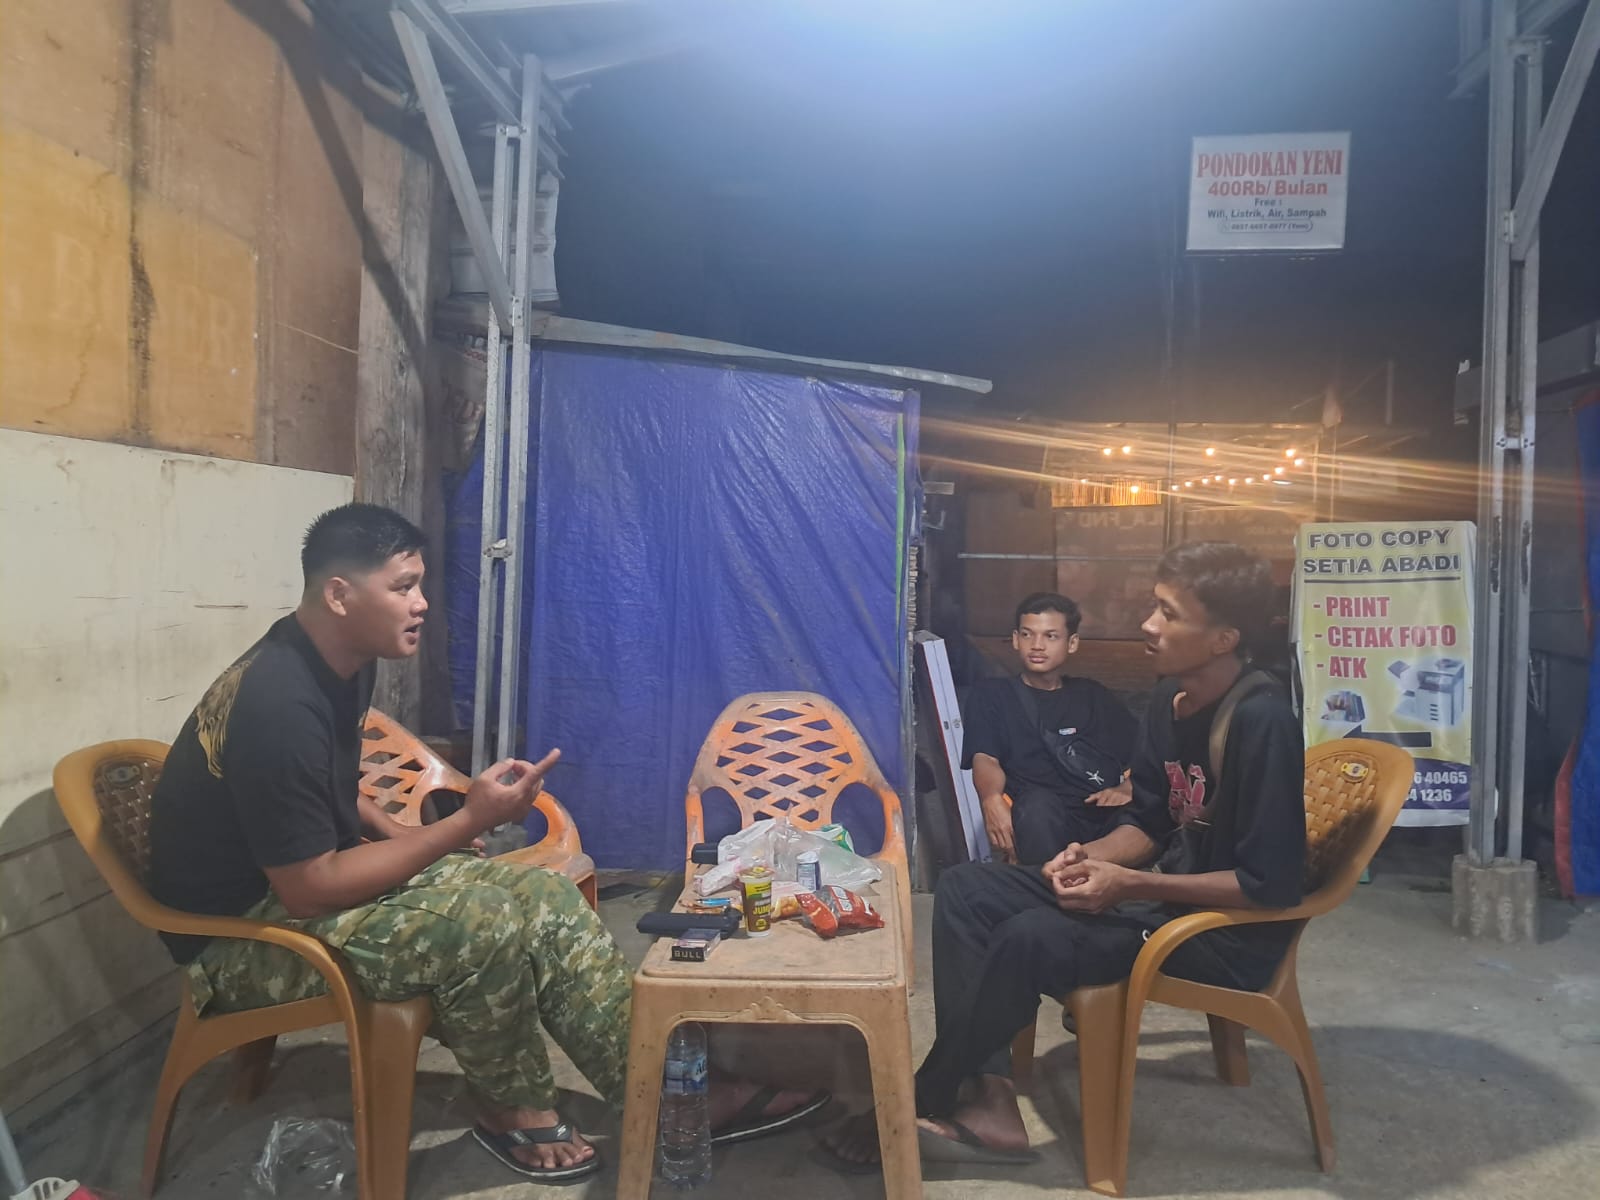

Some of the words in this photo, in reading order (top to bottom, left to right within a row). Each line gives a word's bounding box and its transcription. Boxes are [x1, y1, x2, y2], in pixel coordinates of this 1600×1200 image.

[1197, 150, 1297, 178] PONDOKAN
[1303, 149, 1344, 176] YENI
[1274, 179, 1328, 196] Bulan
[1254, 198, 1276, 207] Free
[1231, 208, 1265, 219] Listrik,
[1268, 208, 1285, 219] Air,
[1287, 207, 1327, 219] Sampah
[1309, 532, 1373, 548] FOTO
[1381, 528, 1451, 546] COPY
[1303, 558, 1373, 574] SETIA
[1381, 554, 1460, 573] ABADI
[1326, 596, 1390, 618] PRINT
[1328, 626, 1394, 648] CETAK
[1400, 625, 1457, 648] FOTO
[1329, 656, 1367, 679] ATK
[1425, 771, 1468, 785] 40465
[1420, 788, 1453, 802] 1236
[674, 950, 701, 959] BULL
